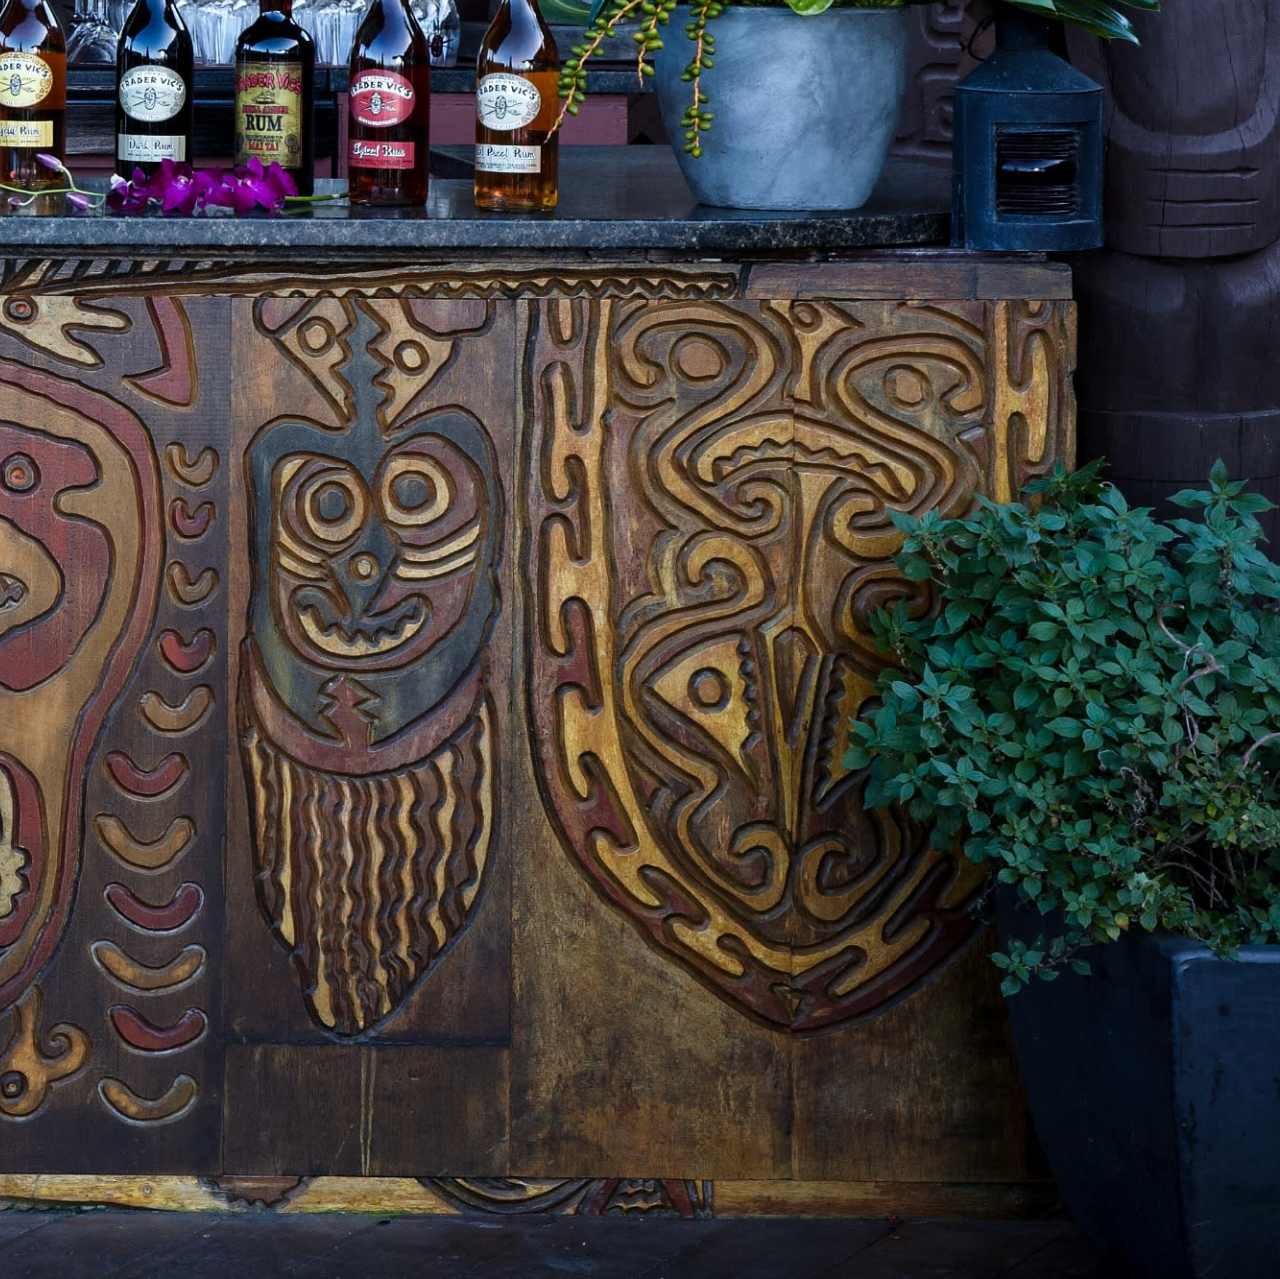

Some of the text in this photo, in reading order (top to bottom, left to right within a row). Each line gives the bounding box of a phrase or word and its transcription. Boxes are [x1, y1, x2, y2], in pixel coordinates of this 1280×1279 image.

[160, 77, 183, 92] VIC'S
[511, 86, 537, 101] VIC'S
[245, 114, 283, 132] RUM
[513, 148, 536, 160] Rum
